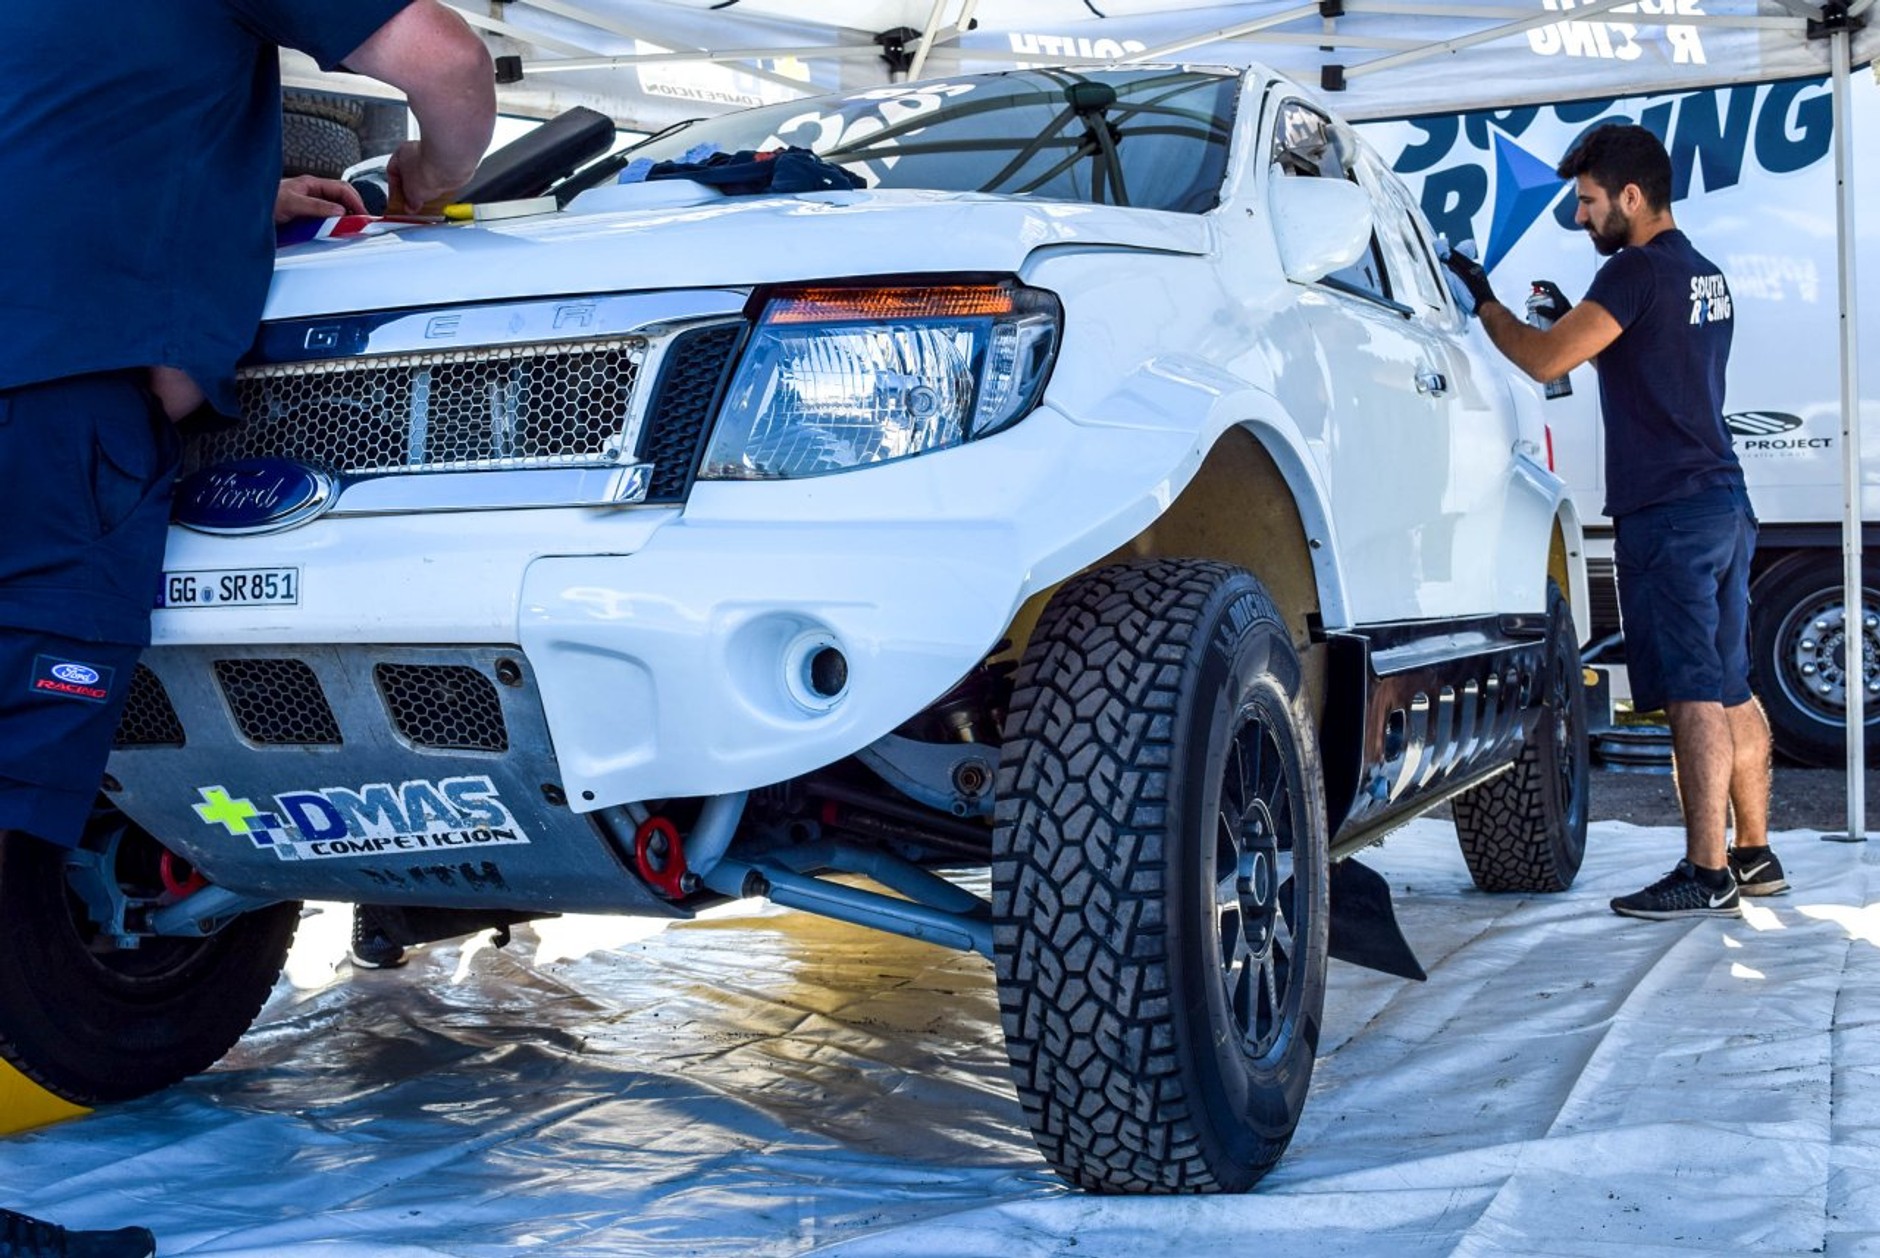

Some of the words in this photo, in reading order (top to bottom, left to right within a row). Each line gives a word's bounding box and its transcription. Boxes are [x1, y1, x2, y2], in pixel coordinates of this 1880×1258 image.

[1689, 273, 1725, 300] SOUTH
[1744, 437, 1833, 450] PROJECT
[196, 470, 285, 509] Ford
[169, 577, 196, 602] GG
[219, 575, 246, 601] SR
[251, 573, 294, 599] 851
[36, 679, 107, 698] RACING
[275, 777, 507, 842] DMAS
[310, 828, 518, 856] COMPETICION
